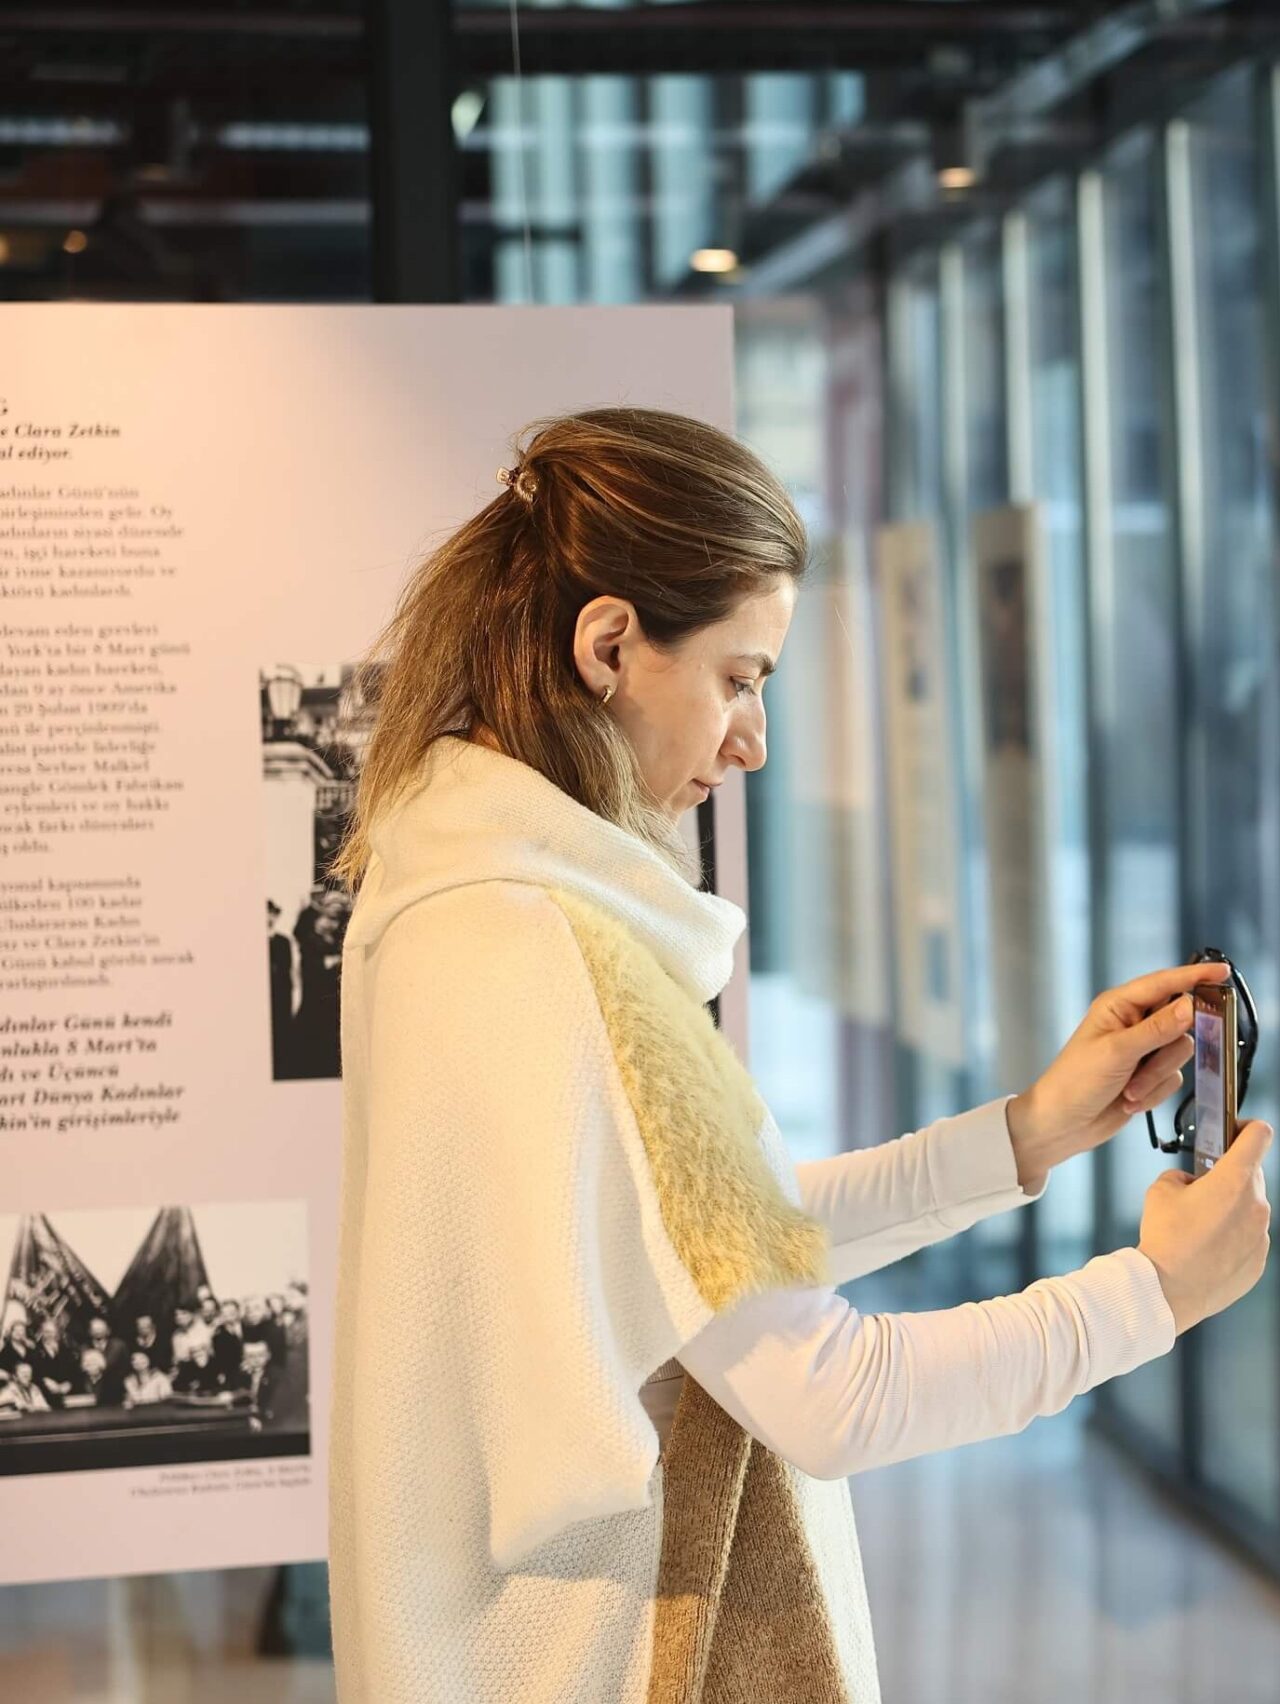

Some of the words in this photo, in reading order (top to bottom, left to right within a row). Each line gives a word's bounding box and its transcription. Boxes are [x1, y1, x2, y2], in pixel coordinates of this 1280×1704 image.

[15, 423, 62, 438] Clara
[69, 423, 120, 438] Zetkin
[18, 446, 70, 464] ediyor.
[0, 485, 52, 500] adınlar
[0, 504, 103, 522] irleşiminden
[0, 524, 68, 540] adınların
[0, 566, 9, 577] ir
[160, 567, 176, 577] ve
[1, 584, 44, 598] ktörü
[66, 642, 86, 655] bir
[108, 642, 144, 655] Mart
[0, 662, 41, 679] layan
[0, 682, 28, 695] dan
[113, 681, 178, 695] Amerika
[0, 741, 26, 755] alist
[0, 765, 31, 774] resa
[0, 782, 42, 797] angle
[0, 877, 43, 895] yonal
[44, 934, 87, 949] Clara
[0, 1015, 57, 1034] dınlar
[64, 1012, 117, 1032] Günü
[122, 1009, 174, 1028] kendi
[1, 1041, 60, 1057] nlukla
[86, 1036, 157, 1055] Mart'ta
[0, 1066, 14, 1082] dı
[21, 1068, 42, 1082] ve
[48, 1057, 120, 1083] Üçüncü
[0, 1091, 25, 1107] art
[33, 1087, 94, 1111] Dünya
[101, 1082, 185, 1103] Kadınlar
[0, 1113, 52, 1131] kin'in
[57, 1108, 181, 1136] girişimleriyle
